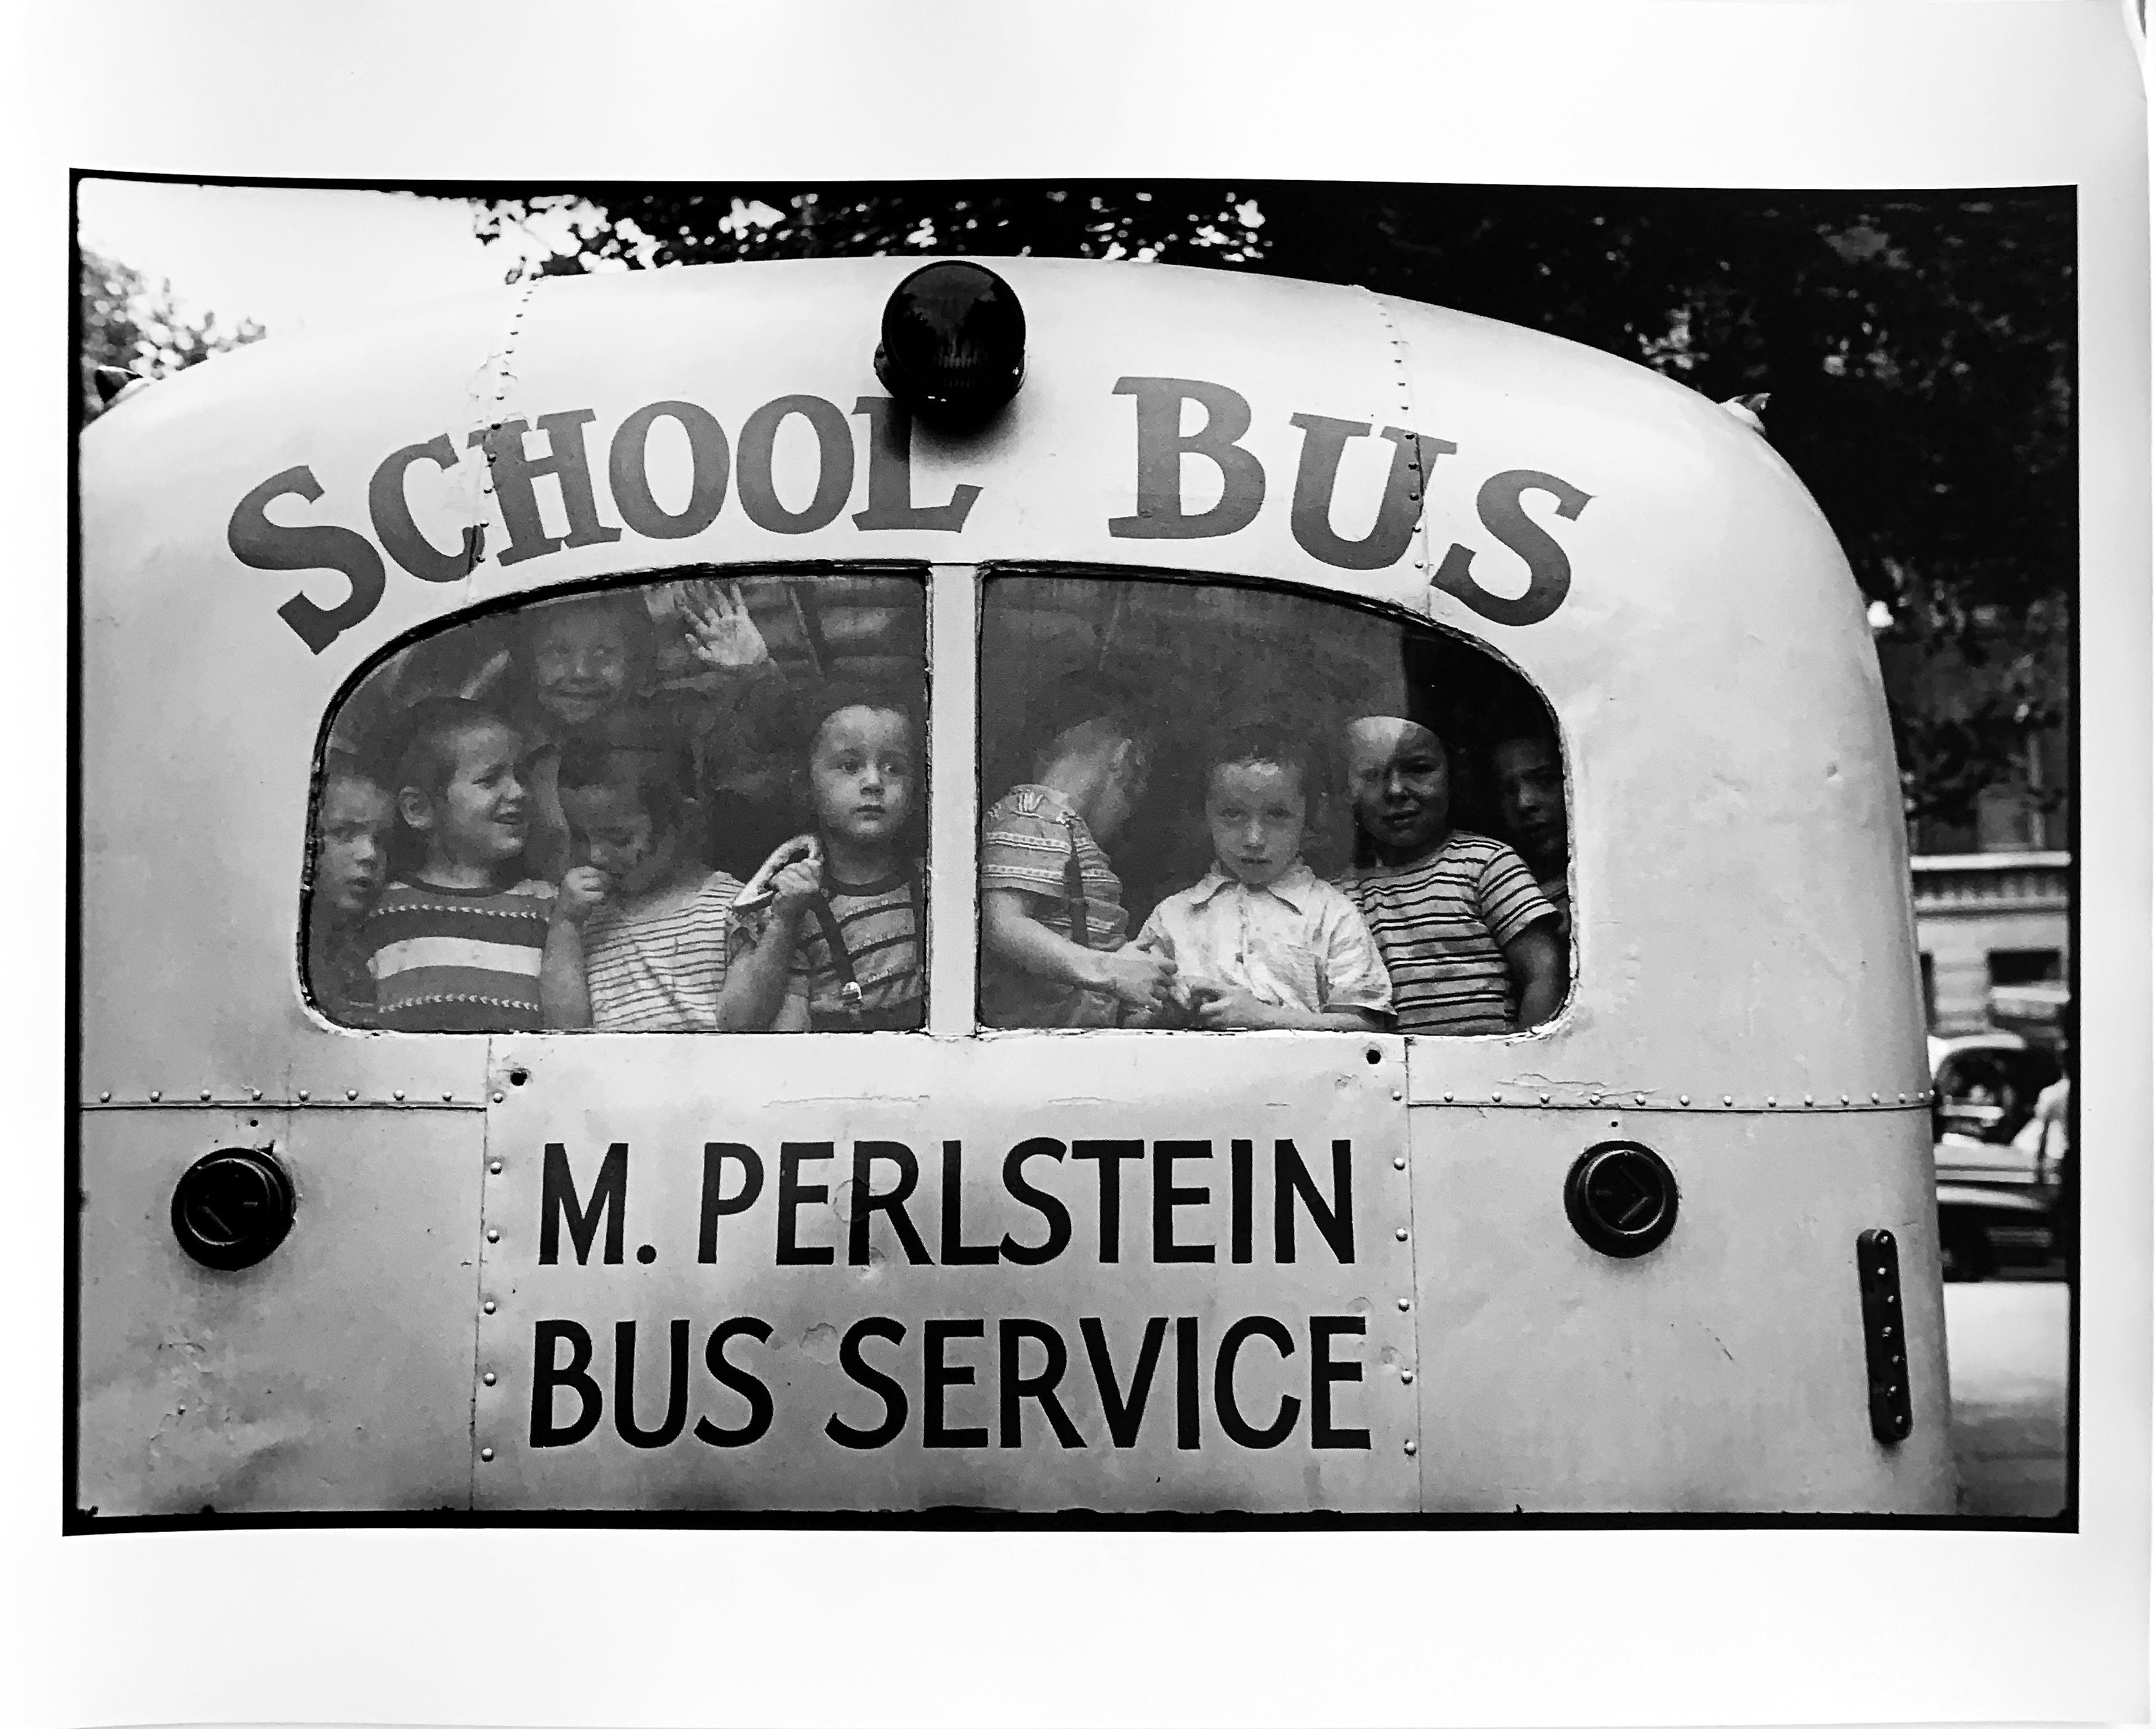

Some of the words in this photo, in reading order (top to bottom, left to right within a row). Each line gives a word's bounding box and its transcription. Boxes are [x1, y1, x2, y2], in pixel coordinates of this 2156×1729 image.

[227, 394, 983, 655] SCHOOL
[1108, 376, 1594, 627] BUS
[538, 1142, 657, 1266] M.
[697, 1136, 1355, 1267] PERLSTEIN
[529, 1316, 774, 1450] BUS
[824, 1315, 1372, 1451] SERVICE
